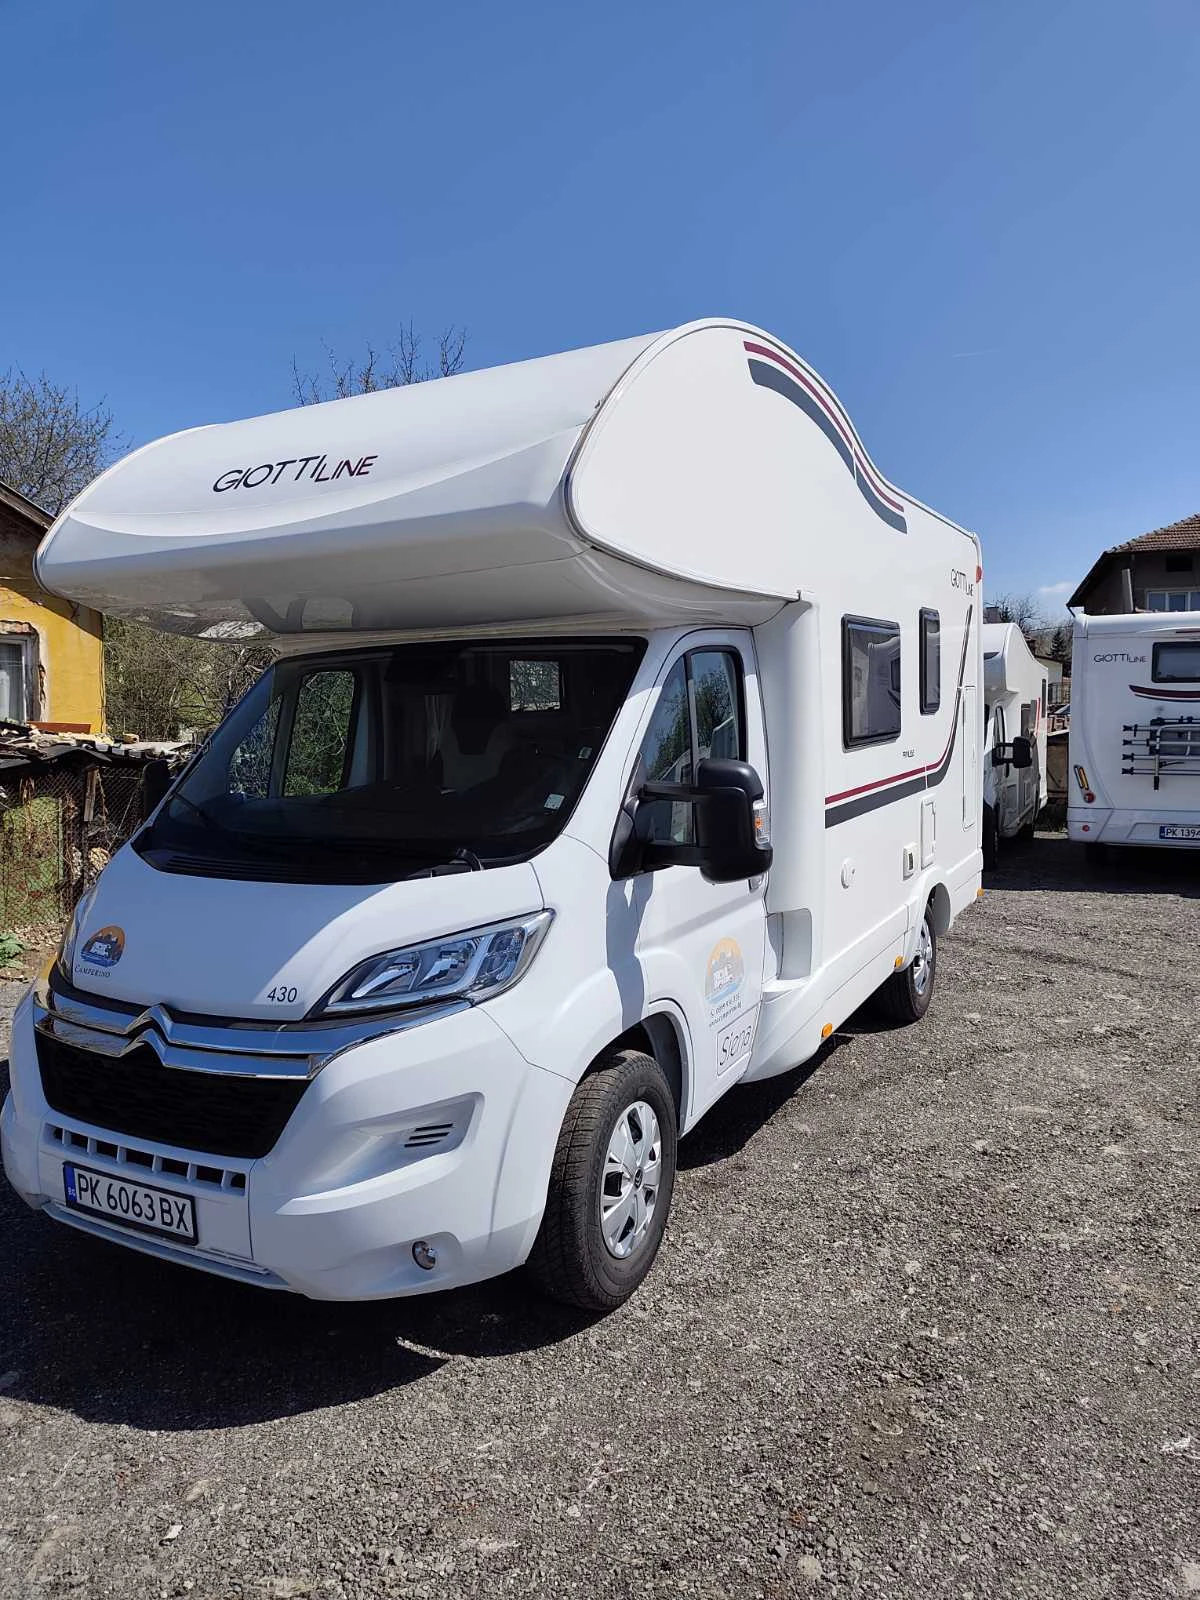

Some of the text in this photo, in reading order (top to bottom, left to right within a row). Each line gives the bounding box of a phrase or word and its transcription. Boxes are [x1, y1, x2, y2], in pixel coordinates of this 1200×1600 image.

[212, 454, 379, 493] GIOTTILINE
[1093, 653, 1149, 663] GIOTTILINE
[1166, 828, 1178, 837] PK
[267, 986, 298, 1003] 430
[719, 1025, 752, 1066] Siena
[77, 1173, 190, 1233] PK 6063 BX
